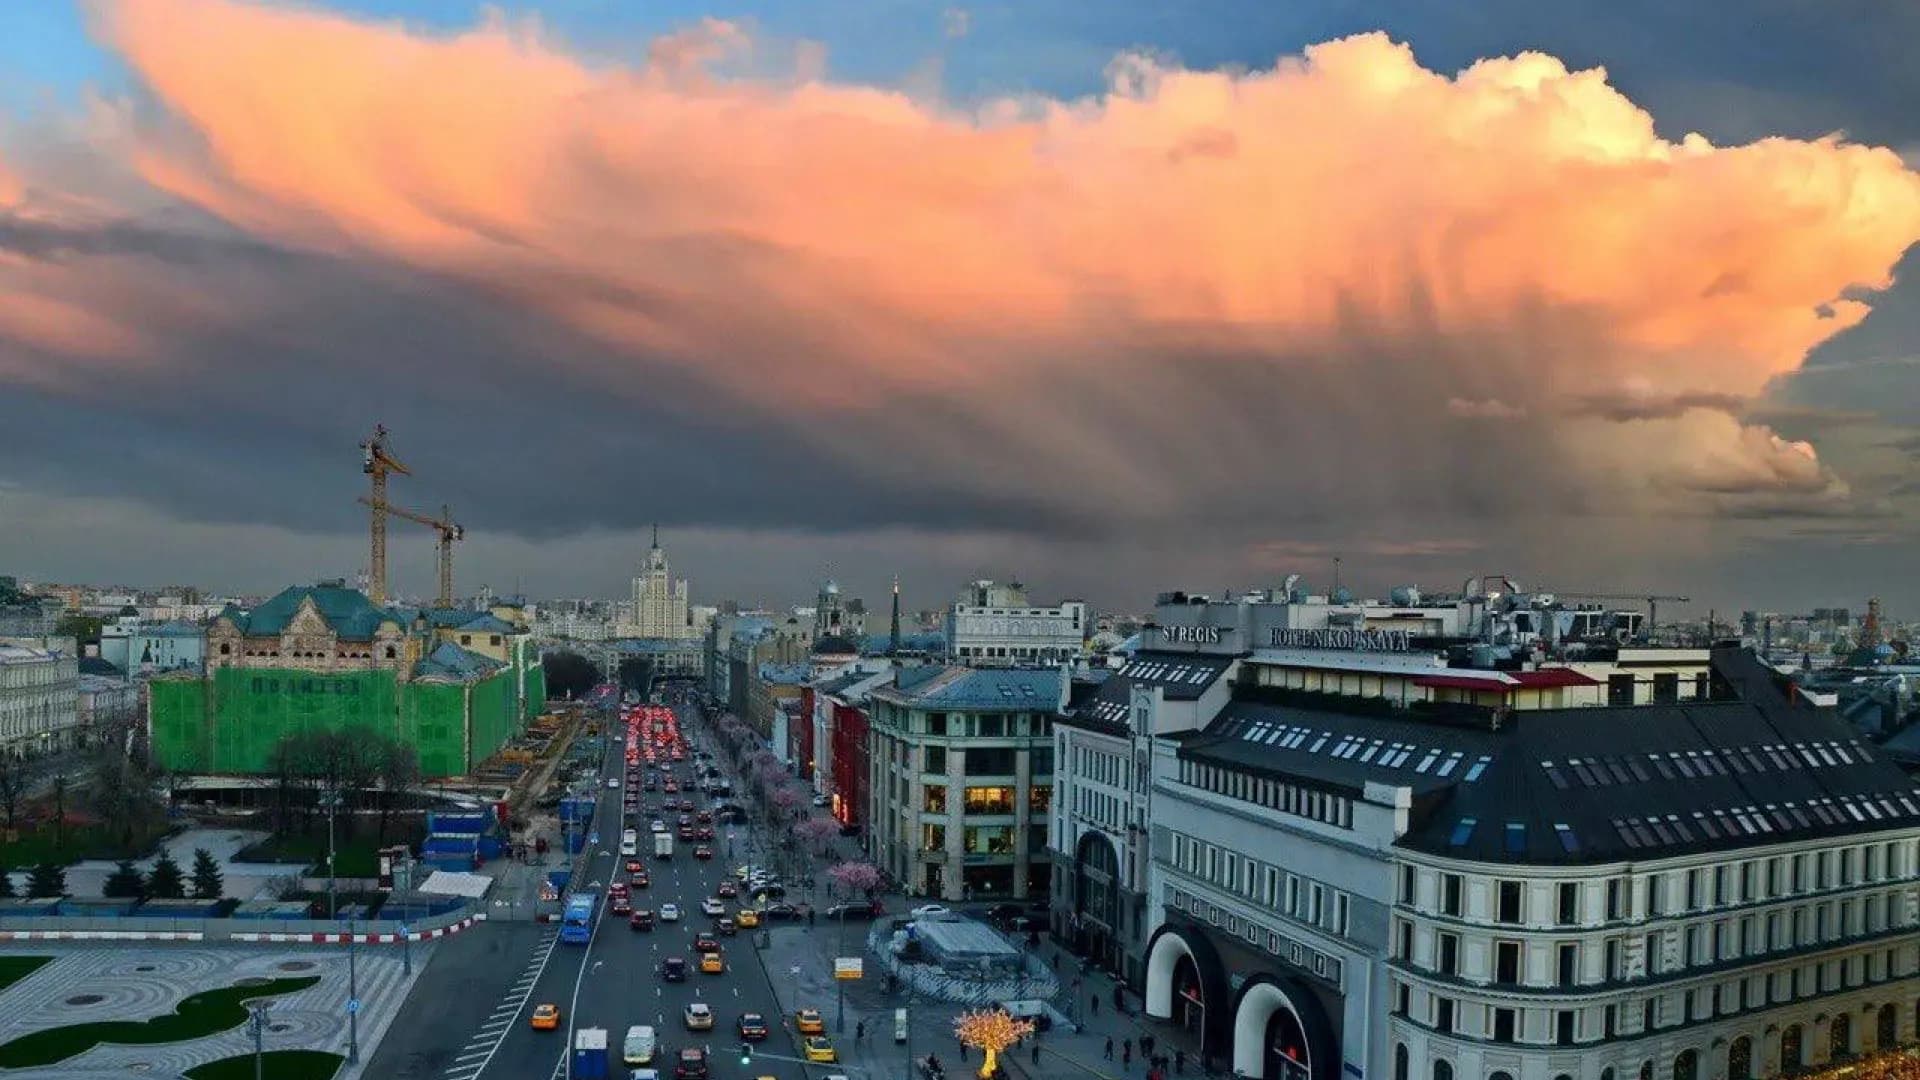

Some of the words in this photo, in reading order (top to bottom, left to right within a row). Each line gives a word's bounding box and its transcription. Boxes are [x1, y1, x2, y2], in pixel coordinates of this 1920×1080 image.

[1162, 626, 1177, 642] ST
[1179, 626, 1219, 643] REGIS
[1271, 628, 1311, 646] HOTEL
